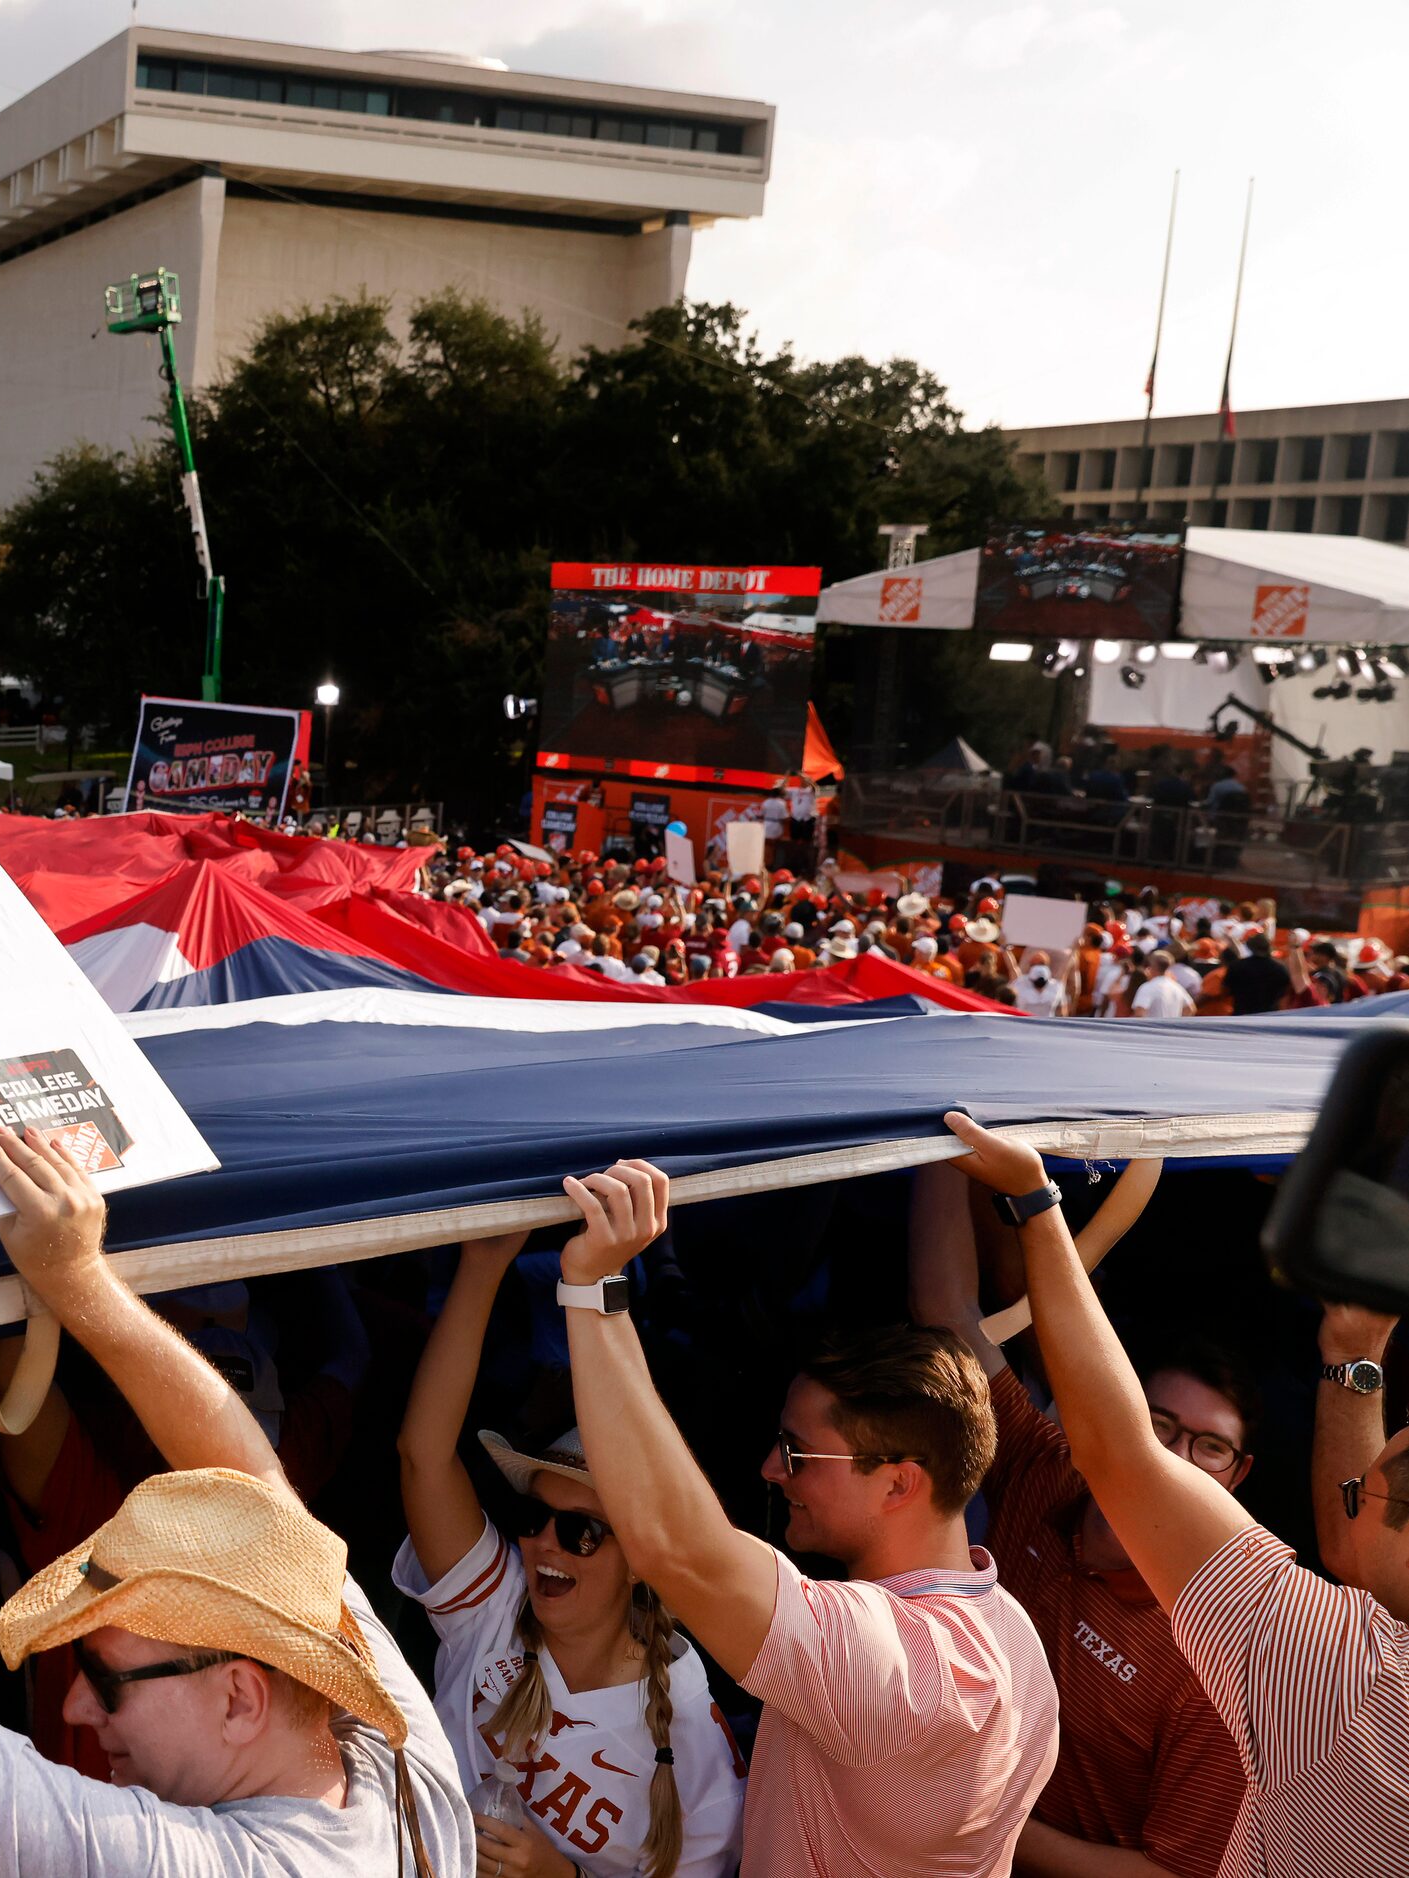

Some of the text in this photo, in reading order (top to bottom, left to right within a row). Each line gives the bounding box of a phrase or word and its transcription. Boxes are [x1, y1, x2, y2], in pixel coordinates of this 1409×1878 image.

[592, 566, 770, 591] THE HOME DEPOT
[149, 750, 276, 795] GAMEDAY
[1073, 1620, 1138, 1682] TEXAS
